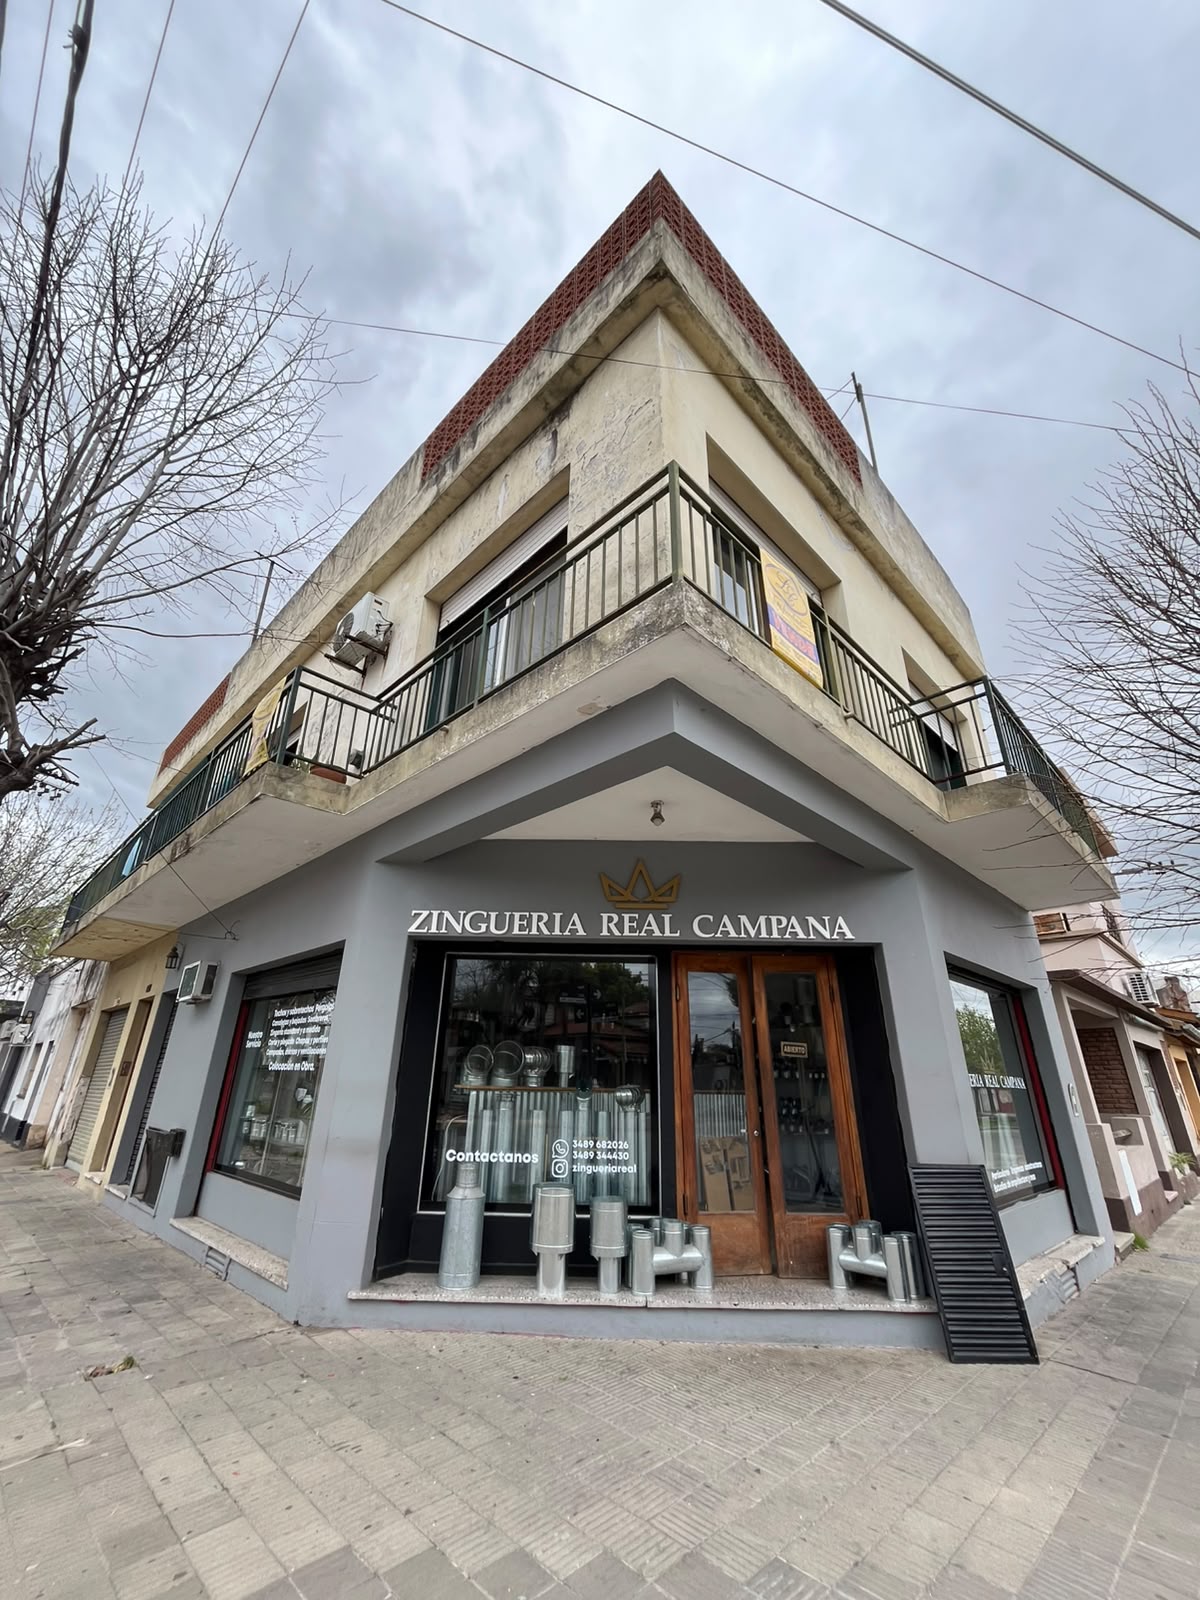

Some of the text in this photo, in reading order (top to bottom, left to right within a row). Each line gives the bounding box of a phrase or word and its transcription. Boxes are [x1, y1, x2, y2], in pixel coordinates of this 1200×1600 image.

[408, 910, 856, 941] ZINGUERIA REAL CAMPANA
[784, 1045, 805, 1054] ABIERTO
[294, 1063, 301, 1071] en
[984, 1074, 1000, 1088] REAL
[1000, 1075, 1027, 1090] CAMPANA
[572, 1139, 629, 1150] 3489 682026
[445, 1148, 539, 1164] Contactanos
[572, 1151, 629, 1161] 3489 344430
[572, 1163, 637, 1175] zingueriareal
